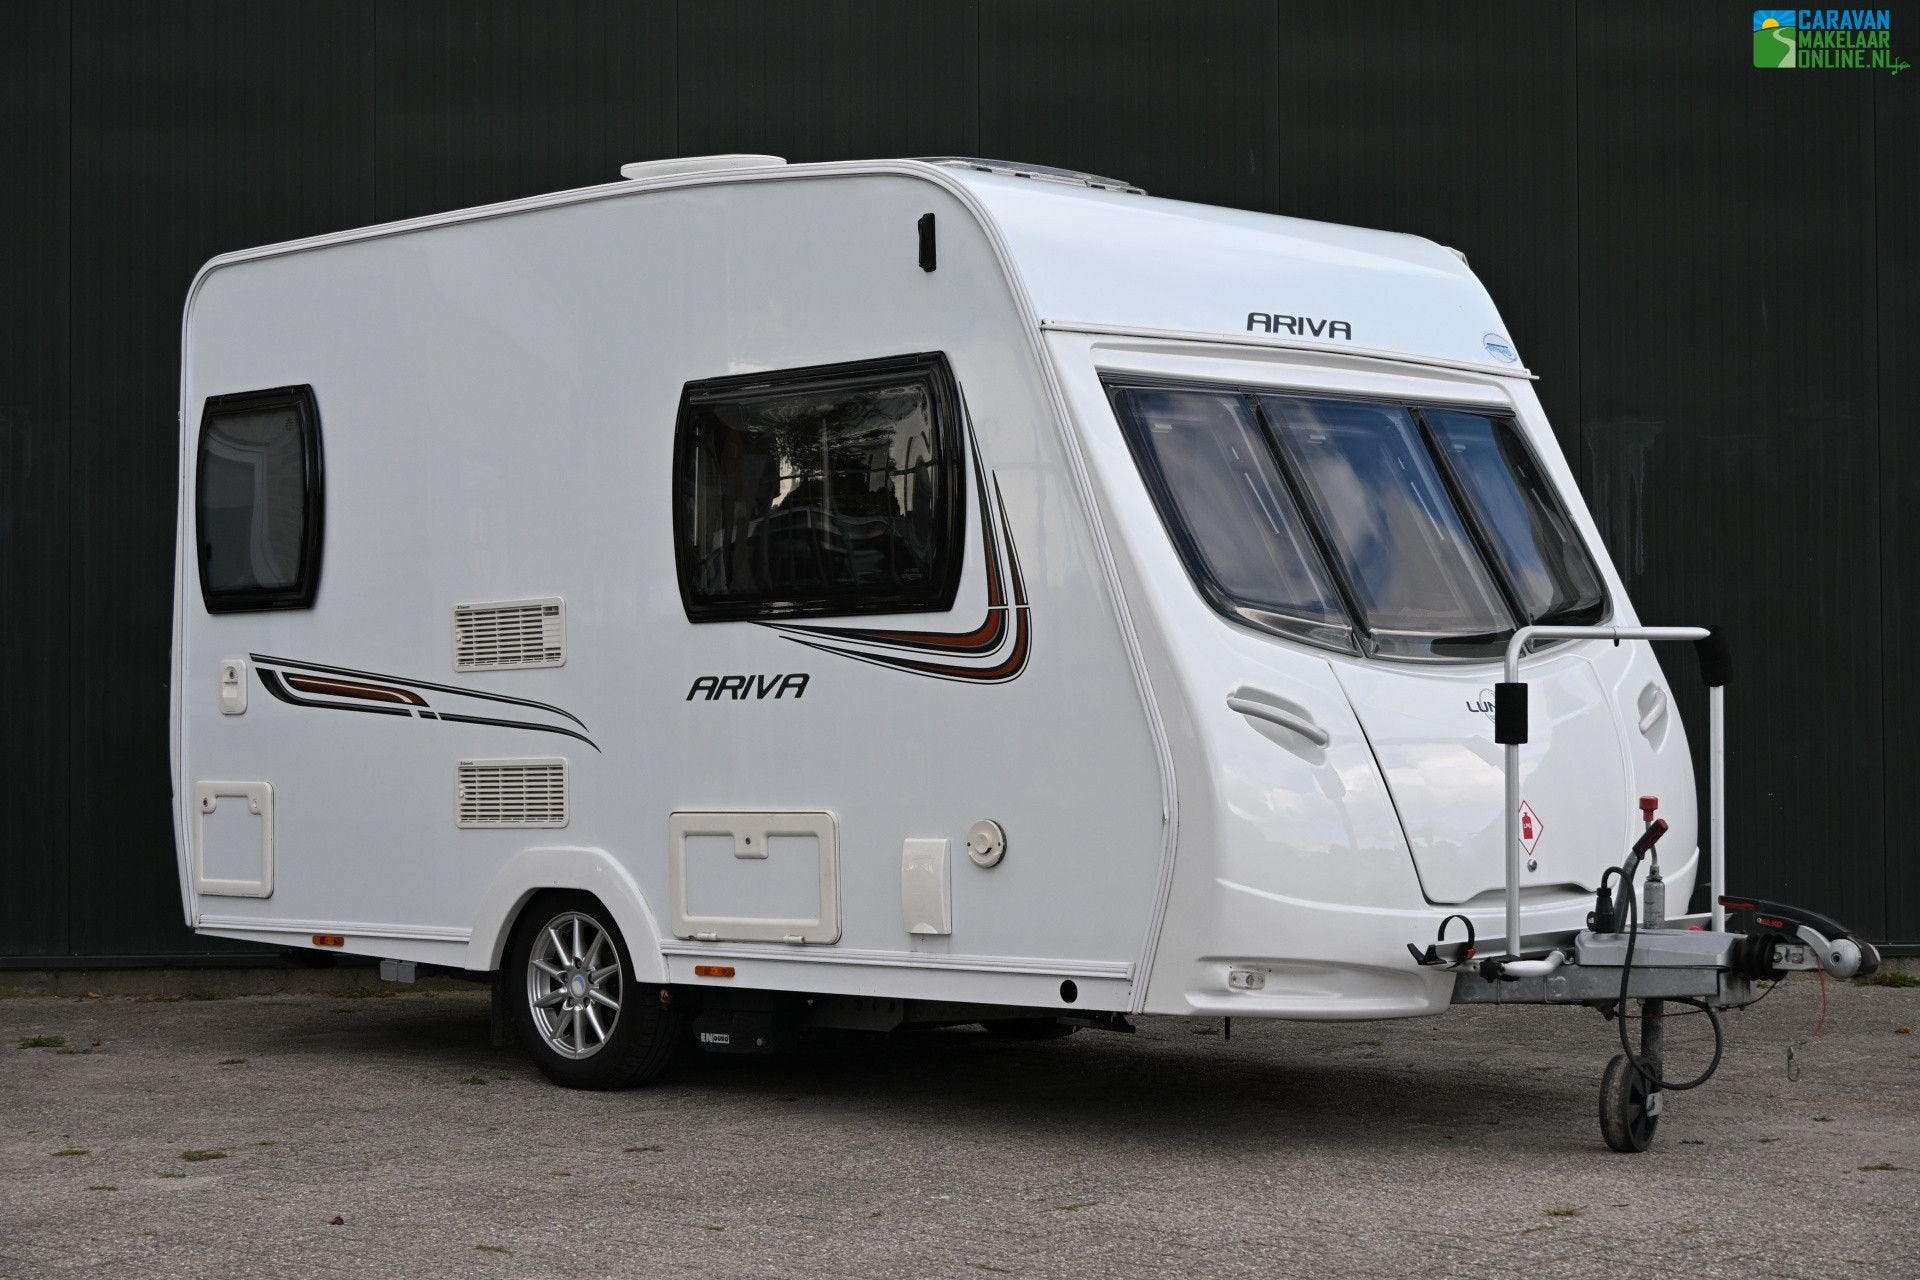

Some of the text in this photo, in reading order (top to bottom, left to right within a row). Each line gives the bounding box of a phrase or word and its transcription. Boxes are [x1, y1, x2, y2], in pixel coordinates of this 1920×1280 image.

[1247, 312, 1352, 340] ARIVA
[686, 673, 810, 701] ARIVA
[1466, 701, 1496, 713] LUN
